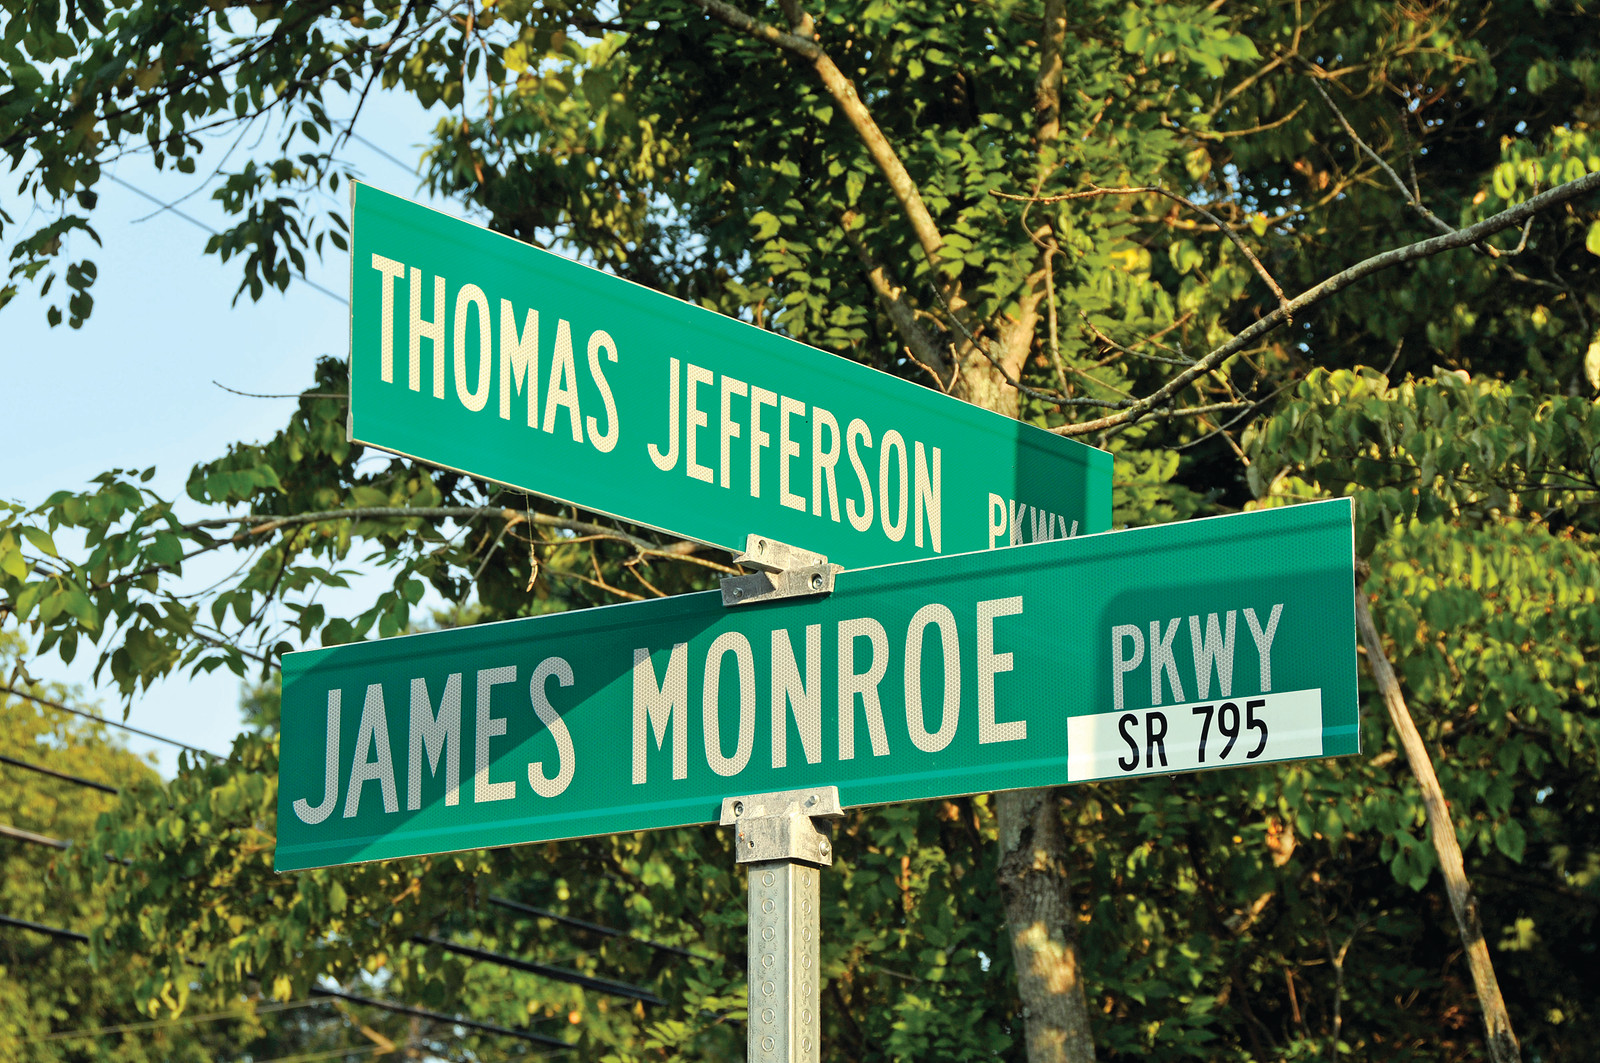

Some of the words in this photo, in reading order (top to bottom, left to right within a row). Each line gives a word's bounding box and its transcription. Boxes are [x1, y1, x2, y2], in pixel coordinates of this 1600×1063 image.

[371, 253, 619, 453] THOMAS
[647, 357, 942, 554] JEFFERSON
[292, 656, 576, 825] JAMES
[632, 596, 1028, 785] MONROE
[1111, 603, 1284, 710] PKWY
[1118, 711, 1168, 772] SR
[1192, 699, 1268, 763] 795
